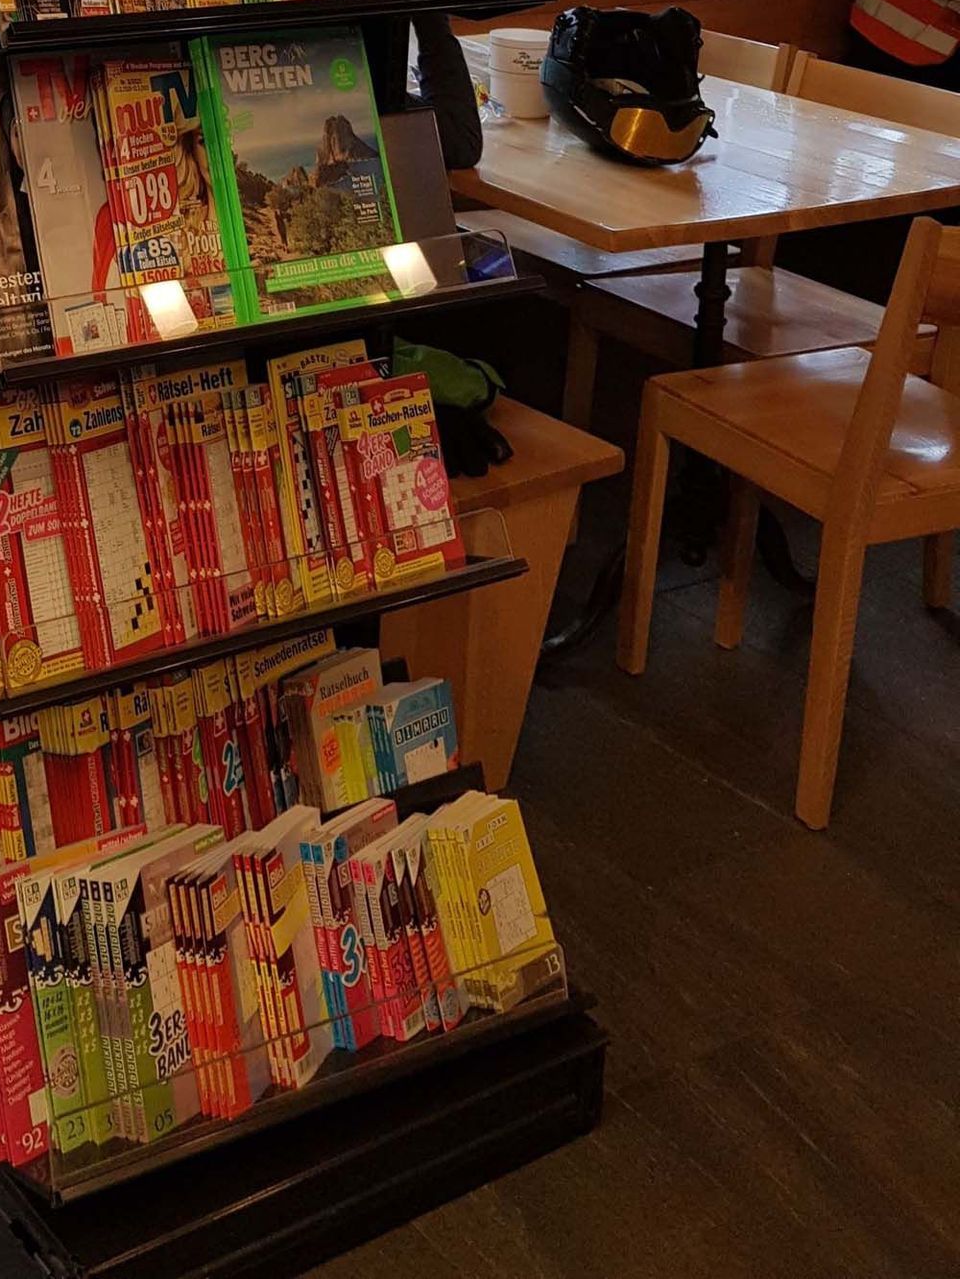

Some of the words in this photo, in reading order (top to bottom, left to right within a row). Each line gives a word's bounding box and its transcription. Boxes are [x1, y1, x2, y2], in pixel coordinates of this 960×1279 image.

[219, 44, 278, 70] BERG
[222, 65, 314, 94] WELTEN
[115, 96, 165, 137] nur
[150, 71, 198, 124] TV
[120, 139, 131, 161] 4
[130, 132, 155, 147] Wochen
[132, 143, 164, 159] Programm
[38, 157, 57, 195] 4
[140, 158, 158, 170] bester
[147, 237, 172, 257] 85
[276, 259, 318, 277] Einmal
[321, 258, 338, 271] um
[340, 252, 356, 268] die
[359, 249, 383, 265] Wel
[20, 286, 43, 303] wi
[156, 367, 234, 402] Rätsel-Heft
[324, 404, 338, 420] Za
[367, 400, 432, 428] Taschen-Rätsel
[364, 448, 395, 480] BAND
[10, 488, 42, 511] HEFTE
[394, 706, 450, 748] BIMARU
[545, 953, 561, 977] 13
[67, 1116, 86, 1140] 23
